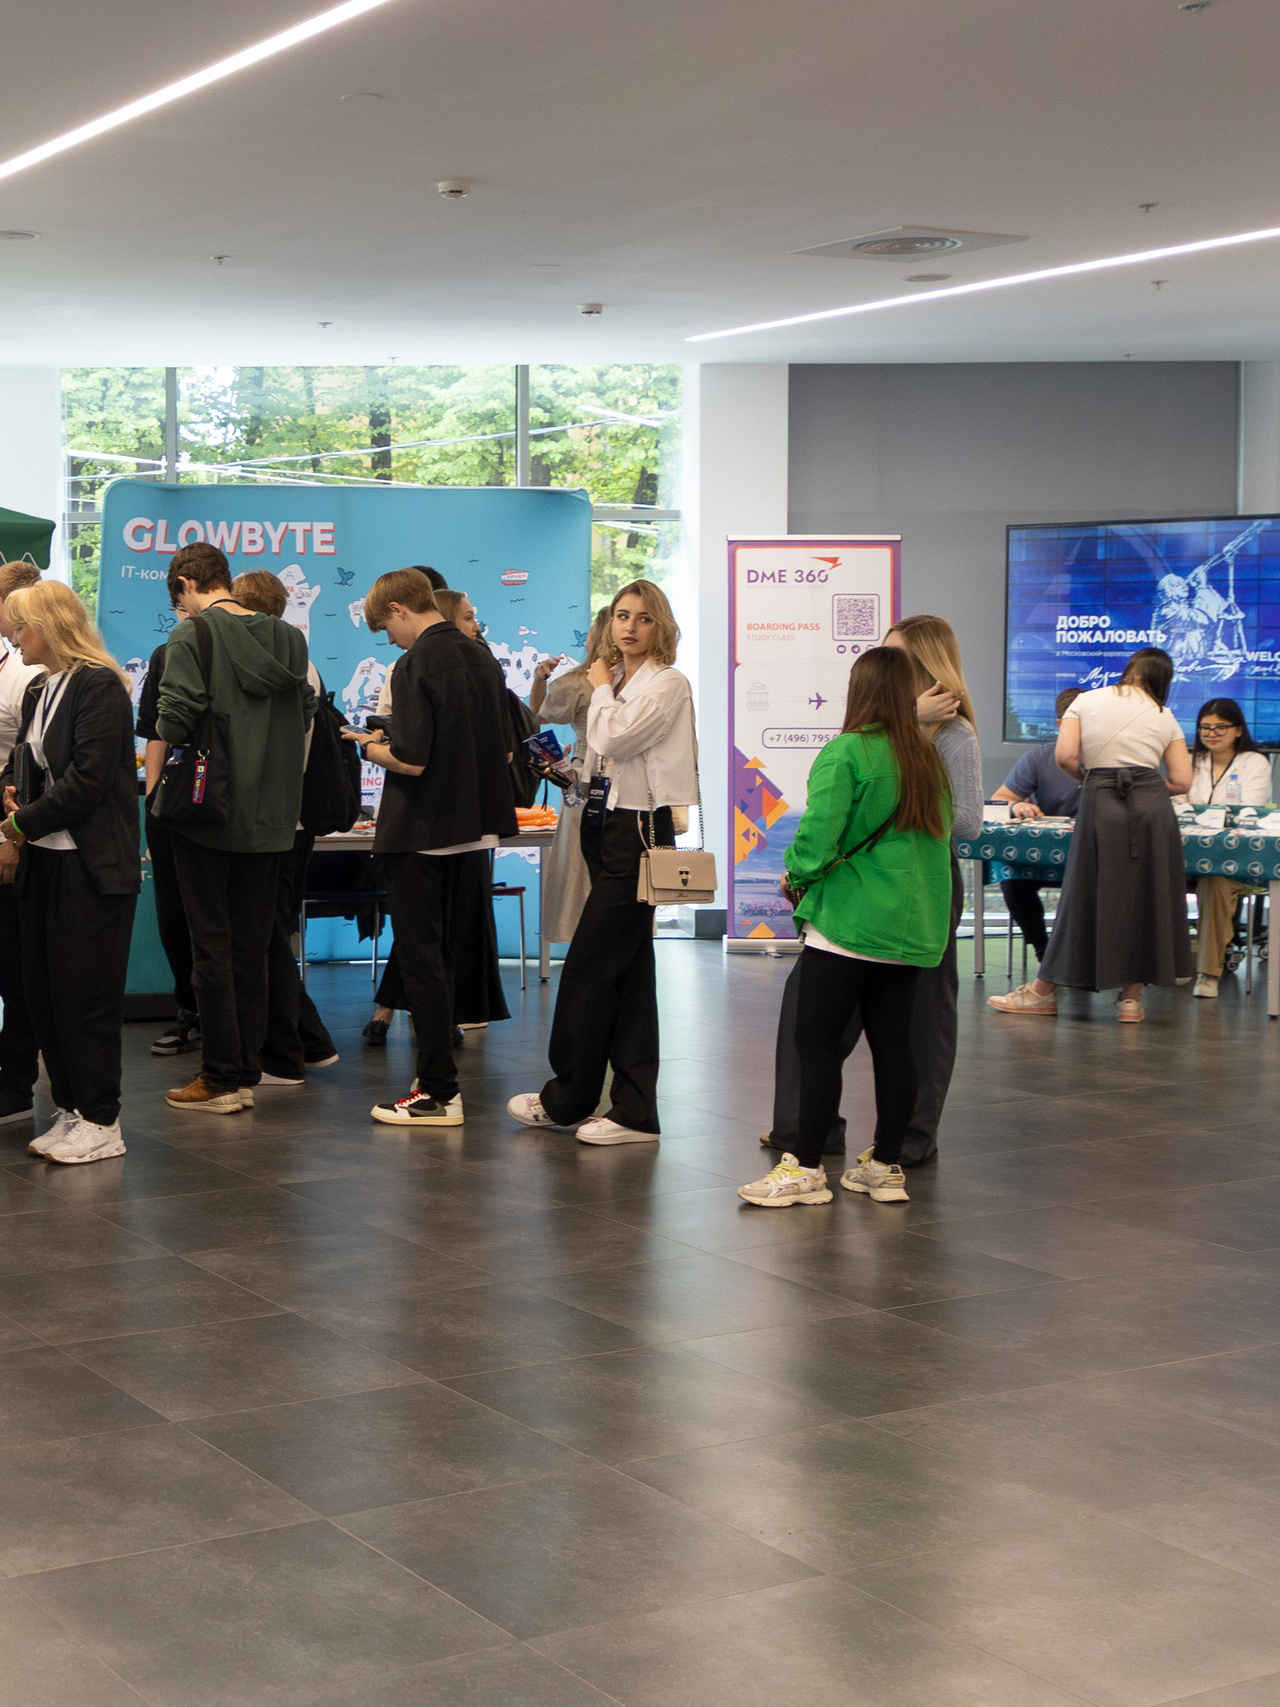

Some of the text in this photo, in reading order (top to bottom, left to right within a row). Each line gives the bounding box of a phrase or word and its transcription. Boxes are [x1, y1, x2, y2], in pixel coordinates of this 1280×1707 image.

[123, 517, 336, 556] GLOWBYTE
[747, 569, 828, 583] DME 360
[747, 622, 821, 631] BOARDING PASS
[1056, 615, 1111, 630] ДОБРО
[1056, 630, 1167, 643] ПОЖАЛОВАТЬ
[769, 734, 782, 743] +7
[784, 734, 809, 743] (496)
